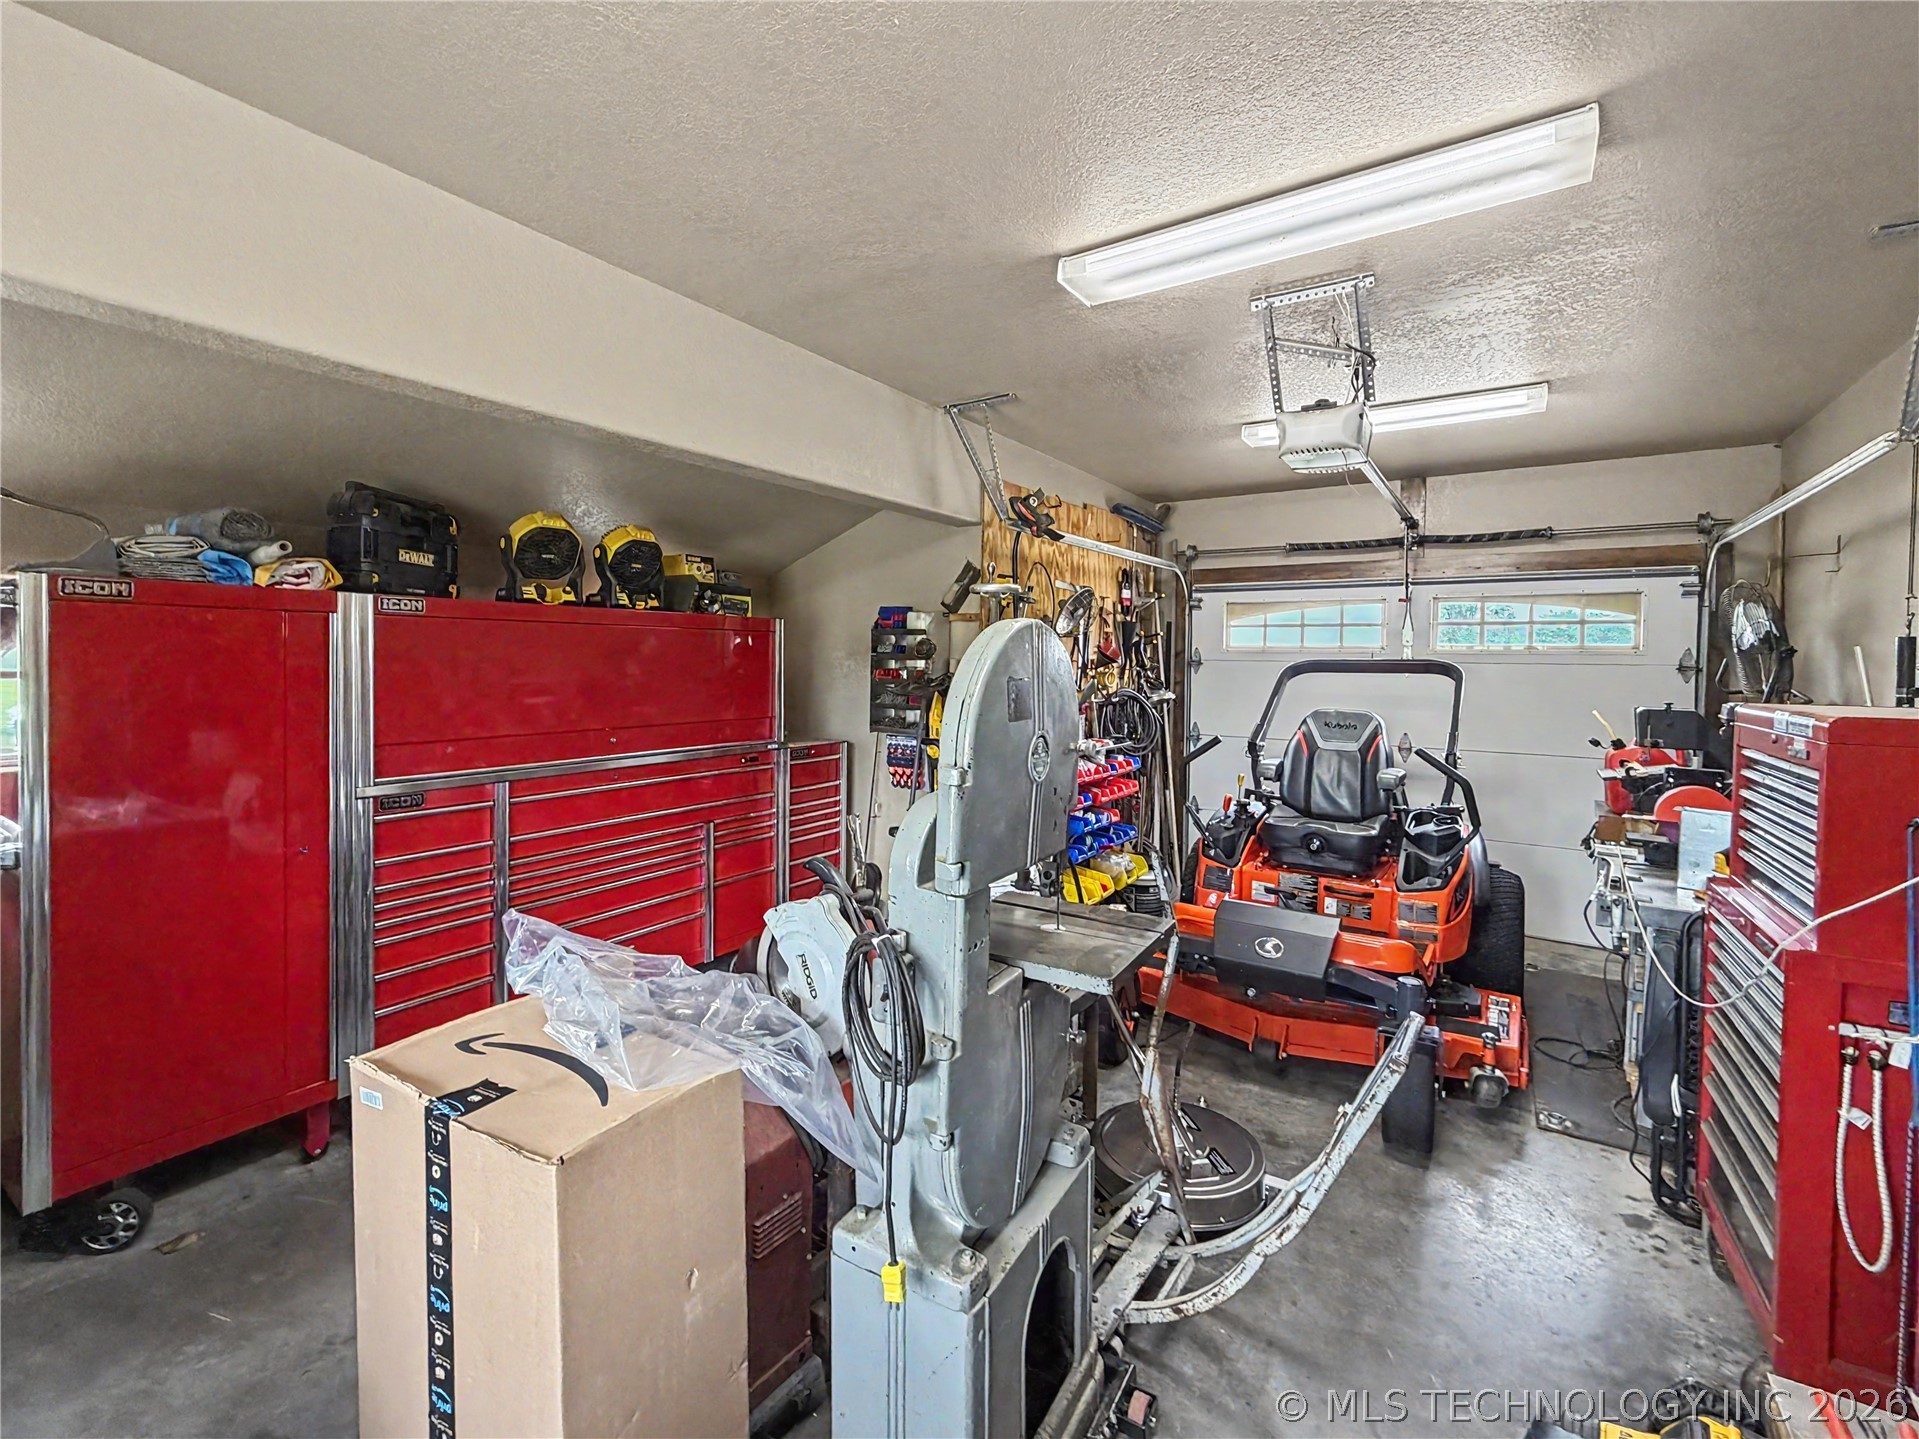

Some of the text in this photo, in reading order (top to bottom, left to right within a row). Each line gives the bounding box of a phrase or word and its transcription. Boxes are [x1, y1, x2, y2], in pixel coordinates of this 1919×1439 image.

[63, 579, 130, 597] ICON
[381, 598, 423, 611] ICON
[381, 794, 423, 810] ICON
[797, 953, 818, 999] RIDGID
